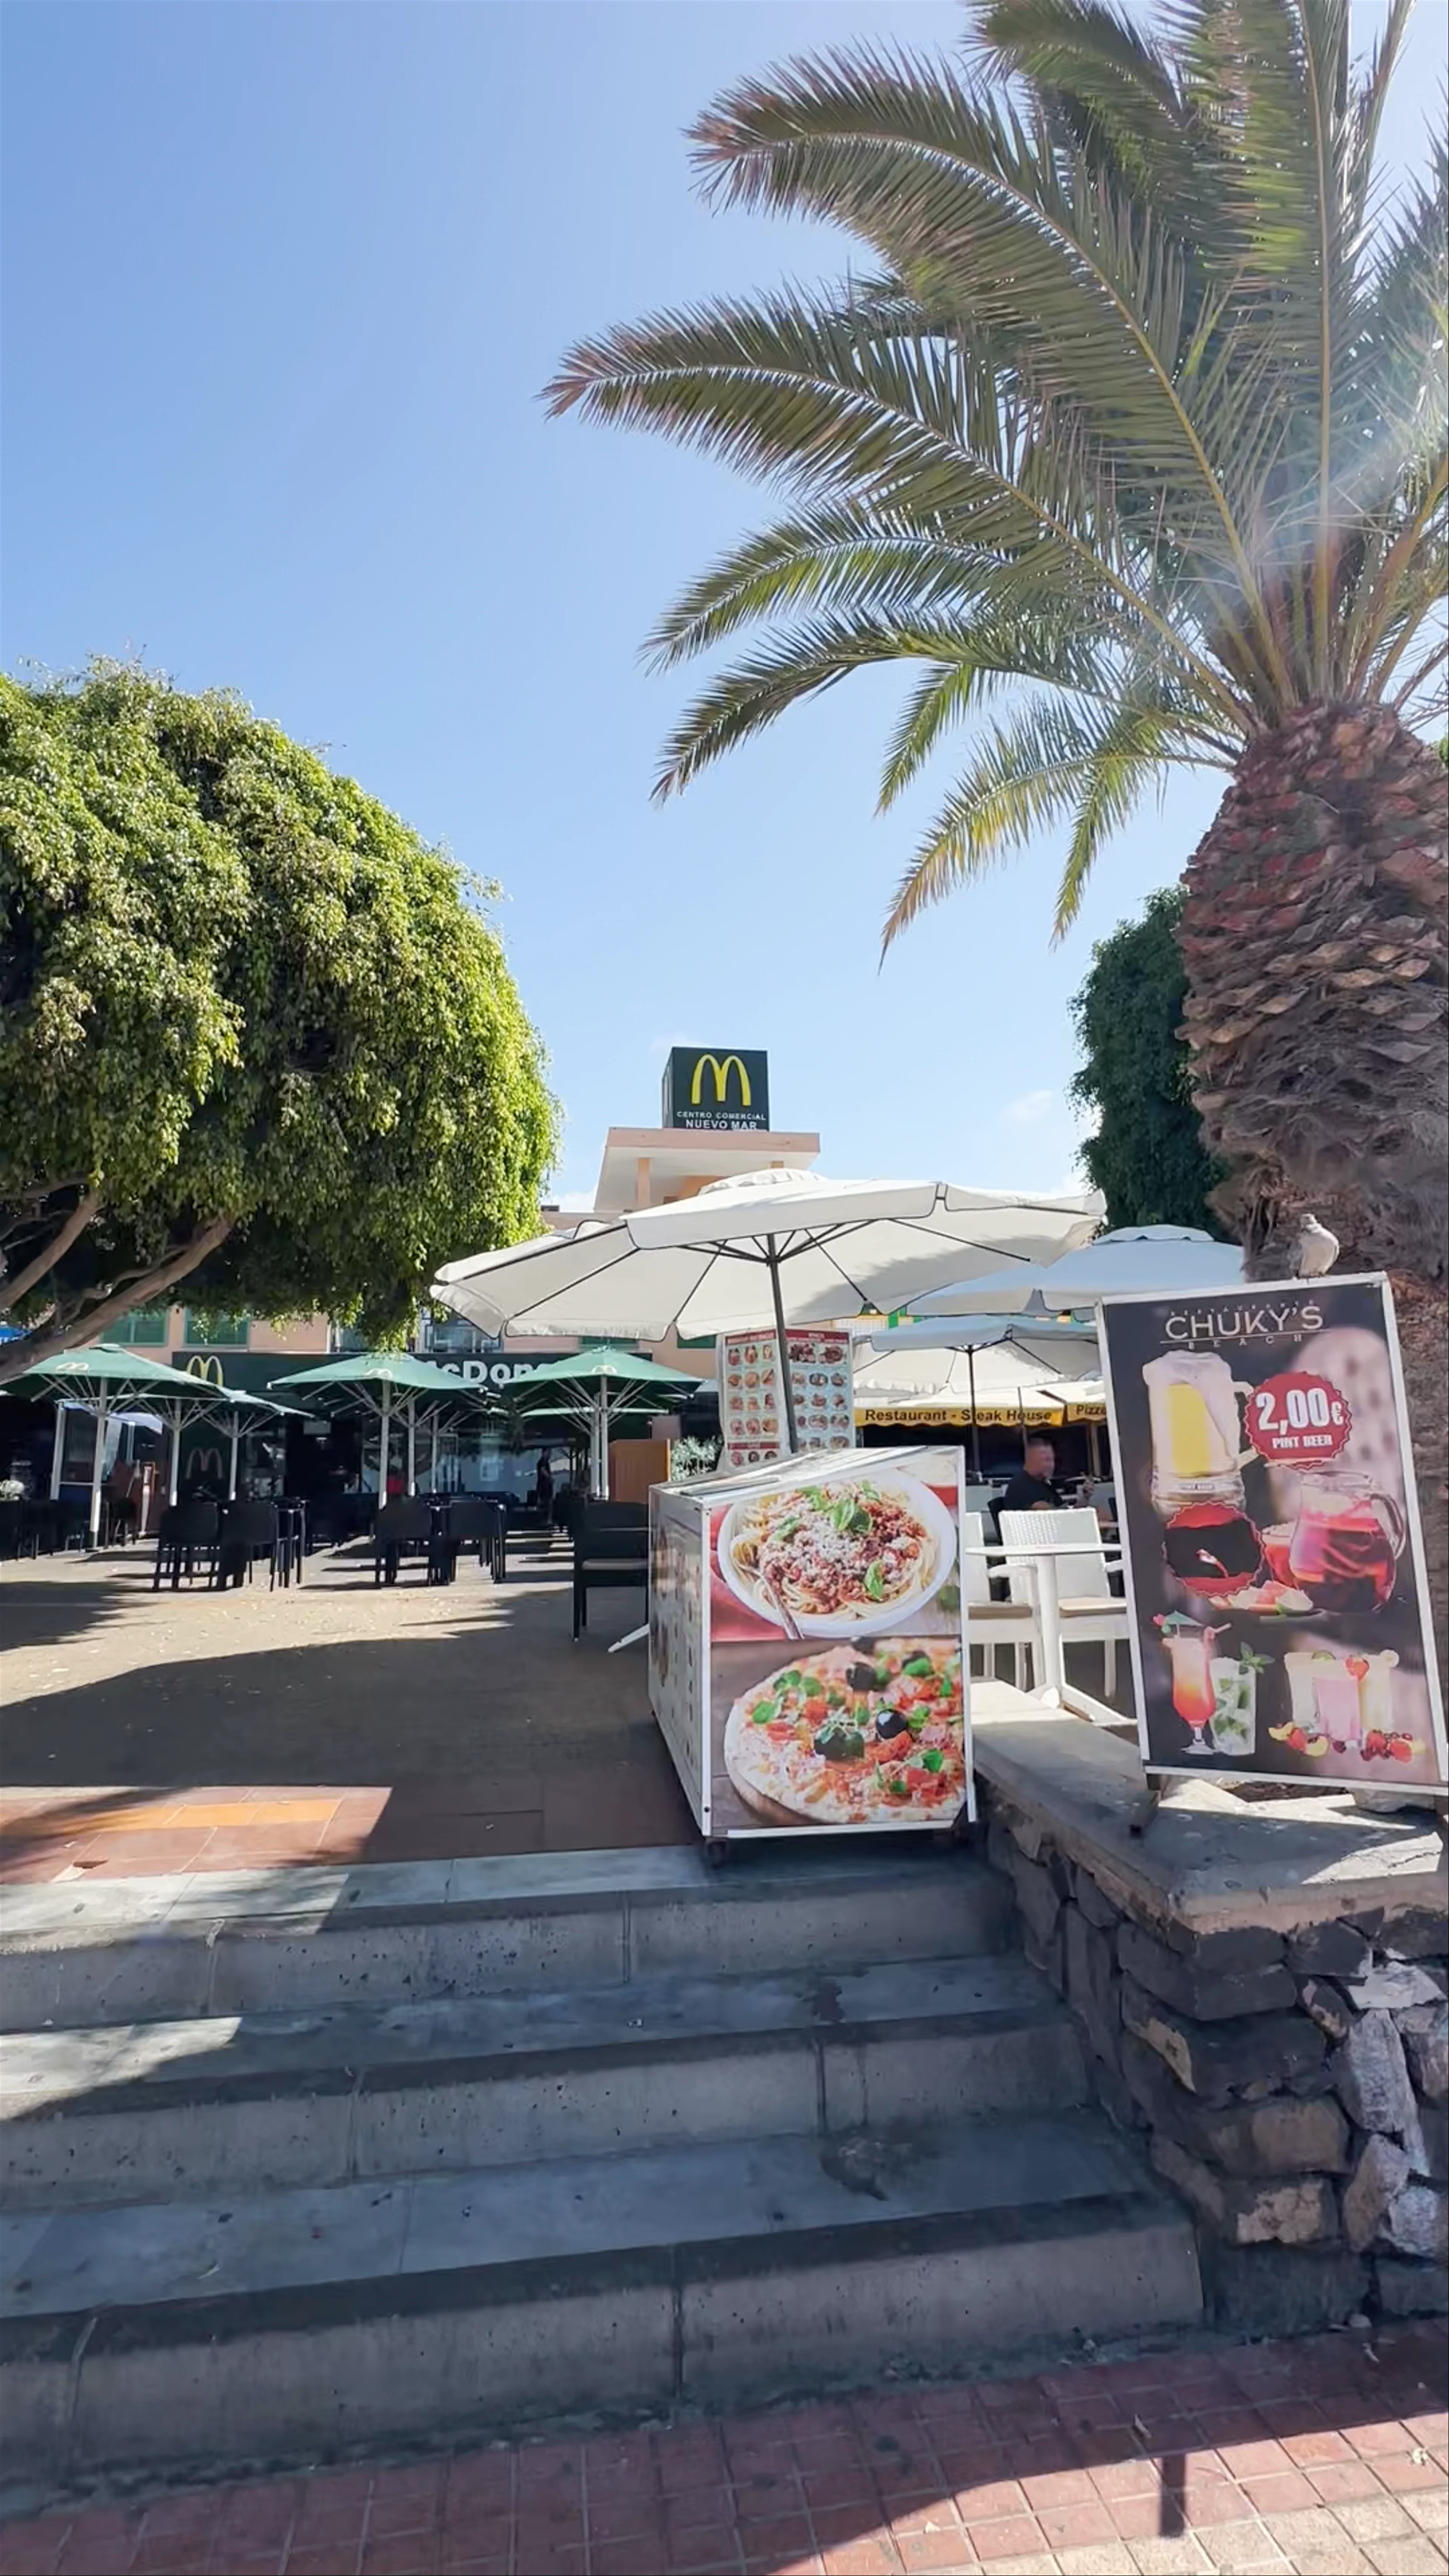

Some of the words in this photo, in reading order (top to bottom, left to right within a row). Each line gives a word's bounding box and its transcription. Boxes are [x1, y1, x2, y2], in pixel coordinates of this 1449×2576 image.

[691, 1054, 751, 1106] M
[686, 1119, 728, 1129] NUEVO
[731, 1121, 757, 1130] MAR
[1165, 1306, 1323, 1340] CHUKY'S
[1188, 1333, 1302, 1350] BEACH
[866, 1409, 946, 1421] Restaurant
[961, 1409, 1001, 1421] Seak
[1256, 1387, 1344, 1435] 2,00€
